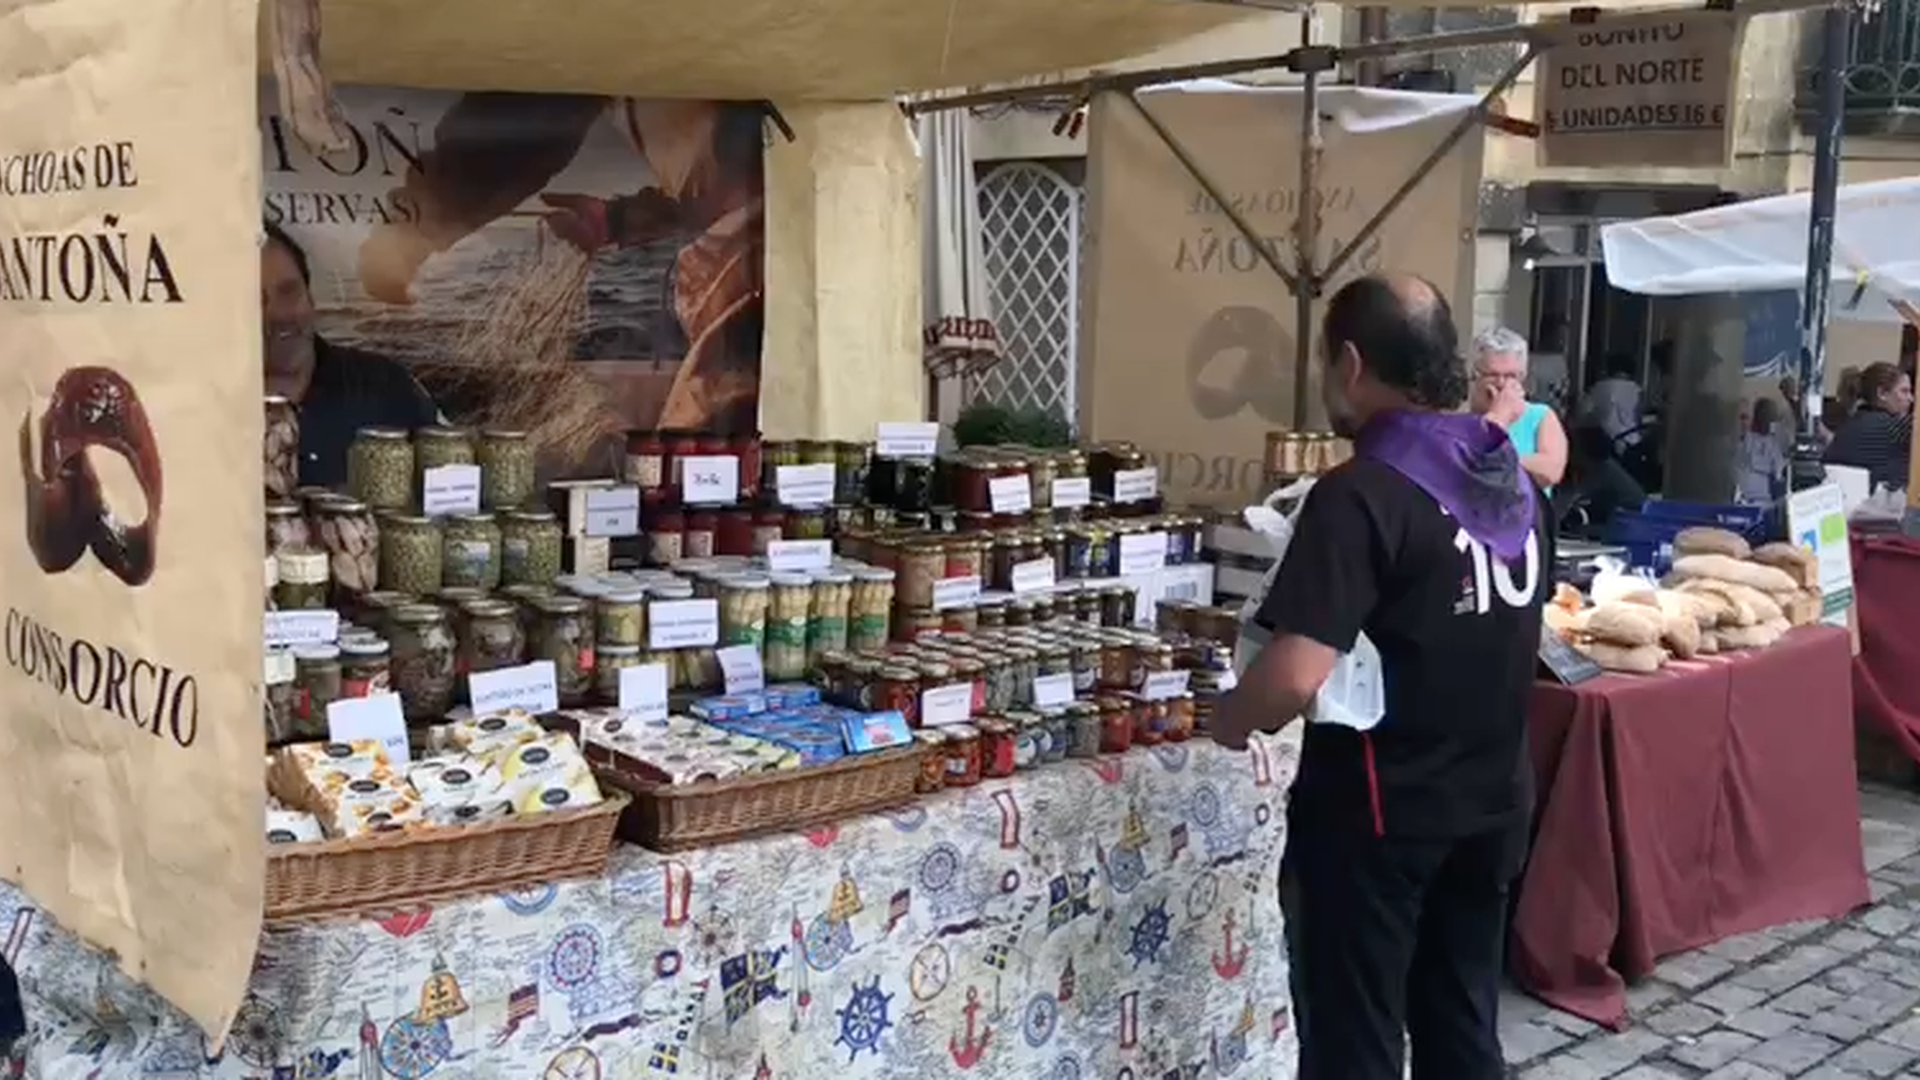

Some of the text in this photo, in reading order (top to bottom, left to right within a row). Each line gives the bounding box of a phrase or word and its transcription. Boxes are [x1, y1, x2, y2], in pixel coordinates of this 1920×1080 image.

[1561, 57, 1704, 89] DEL NORTE
[1562, 104, 1678, 129] UNIDADES
[95, 141, 138, 188] DE
[1454, 526, 1539, 615] 10
[5, 607, 198, 748] CONSORCIO
